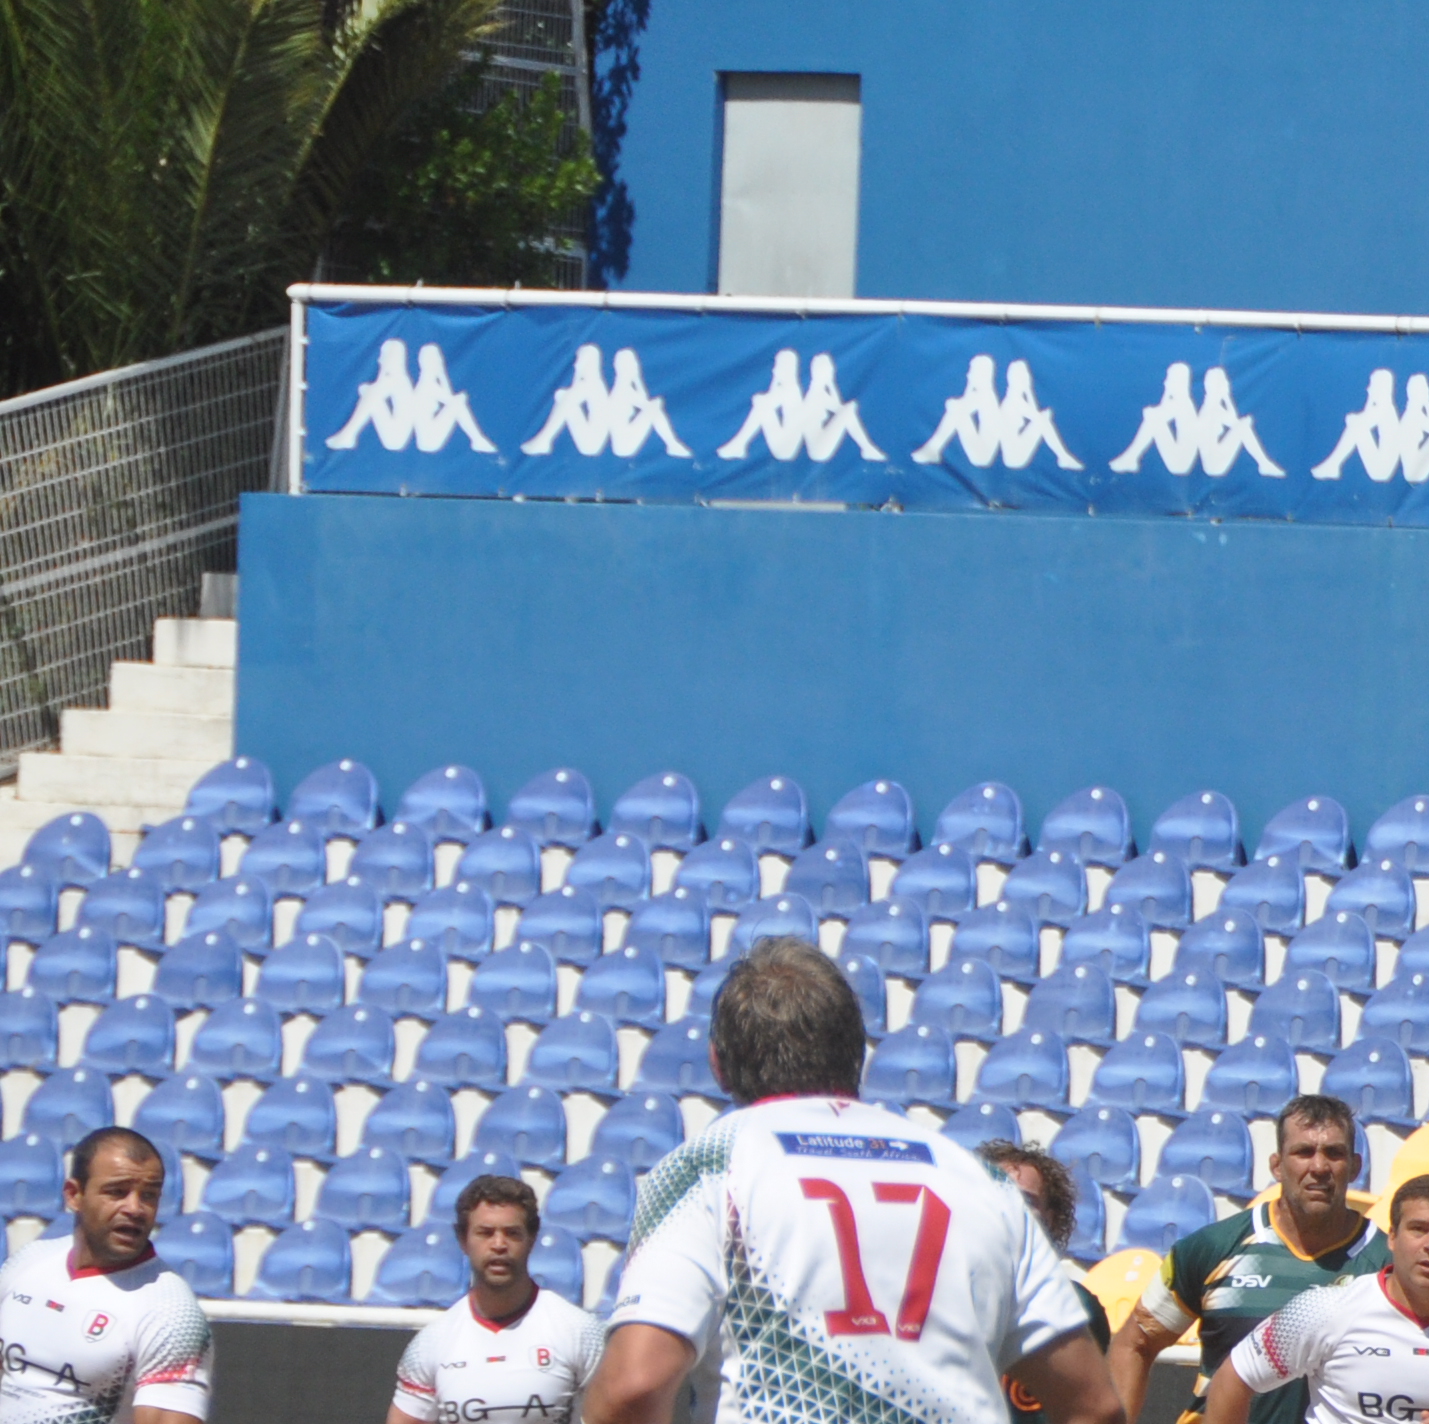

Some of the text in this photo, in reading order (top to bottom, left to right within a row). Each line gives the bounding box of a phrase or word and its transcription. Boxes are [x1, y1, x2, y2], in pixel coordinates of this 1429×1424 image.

[796, 1133, 865, 1149] Latitude
[798, 1177, 952, 1343] 17
[1231, 1274, 1272, 1289] DSV
